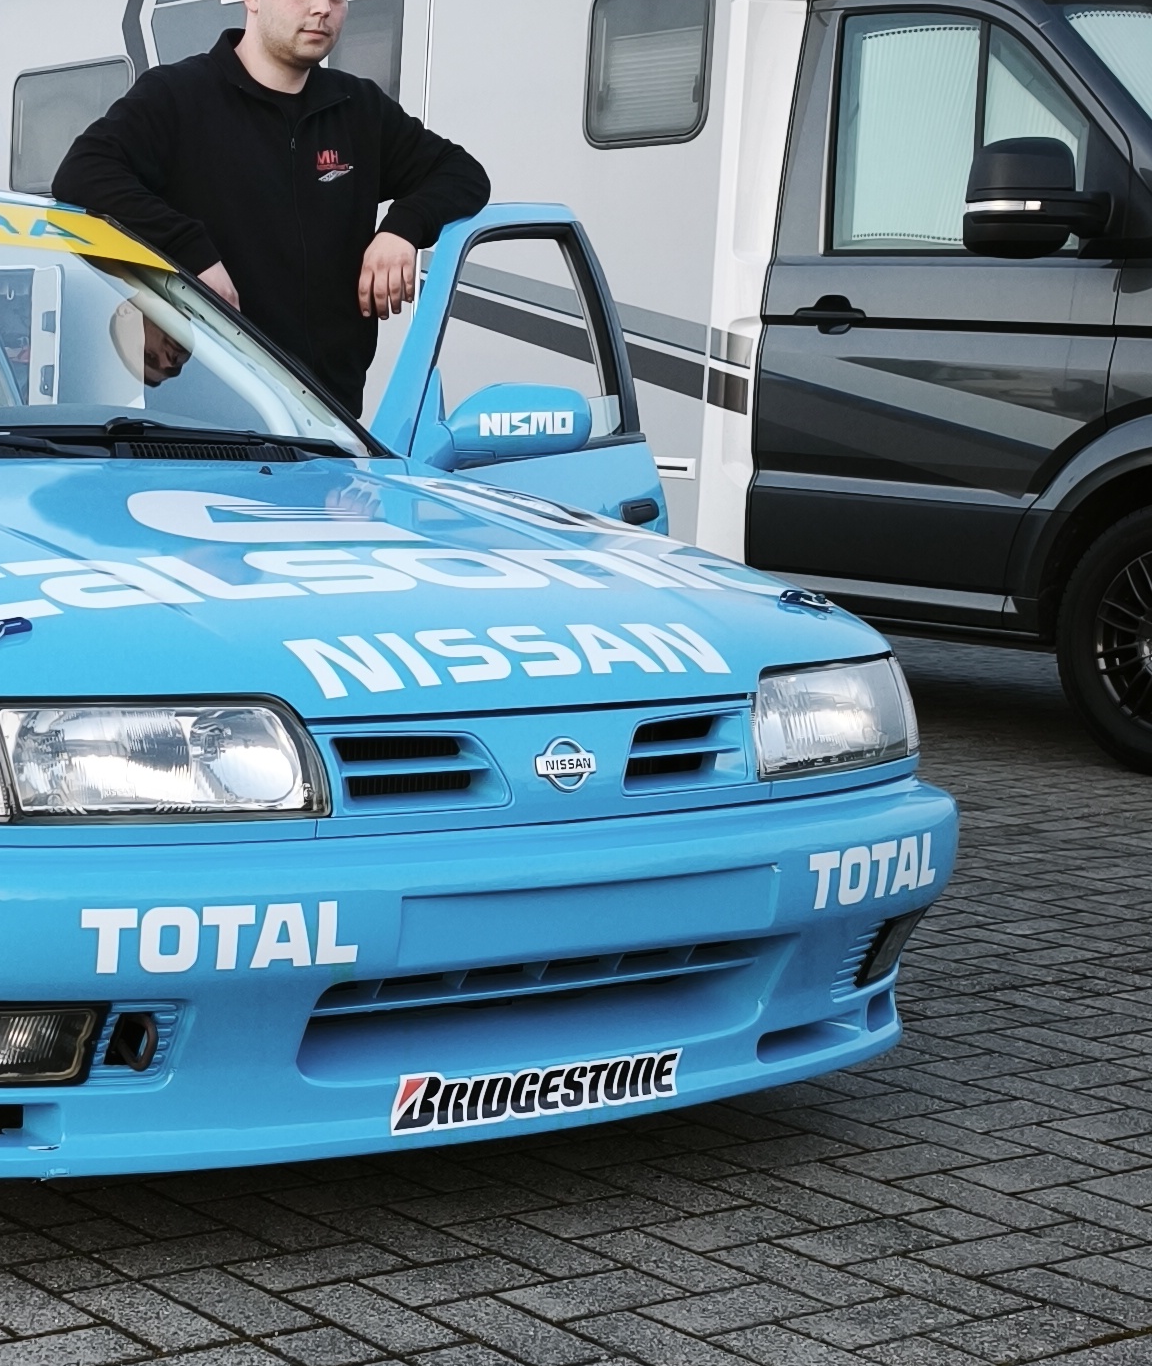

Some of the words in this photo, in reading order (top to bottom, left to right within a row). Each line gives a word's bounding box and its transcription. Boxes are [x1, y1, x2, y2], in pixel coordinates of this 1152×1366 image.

[480, 412, 574, 437] NISMO
[283, 623, 731, 700] NISSAN
[546, 758, 591, 771] NISSAN
[809, 832, 936, 909] TOTAL
[81, 900, 358, 974] TOTAL
[396, 1050, 678, 1133] BRIDGESTONE
